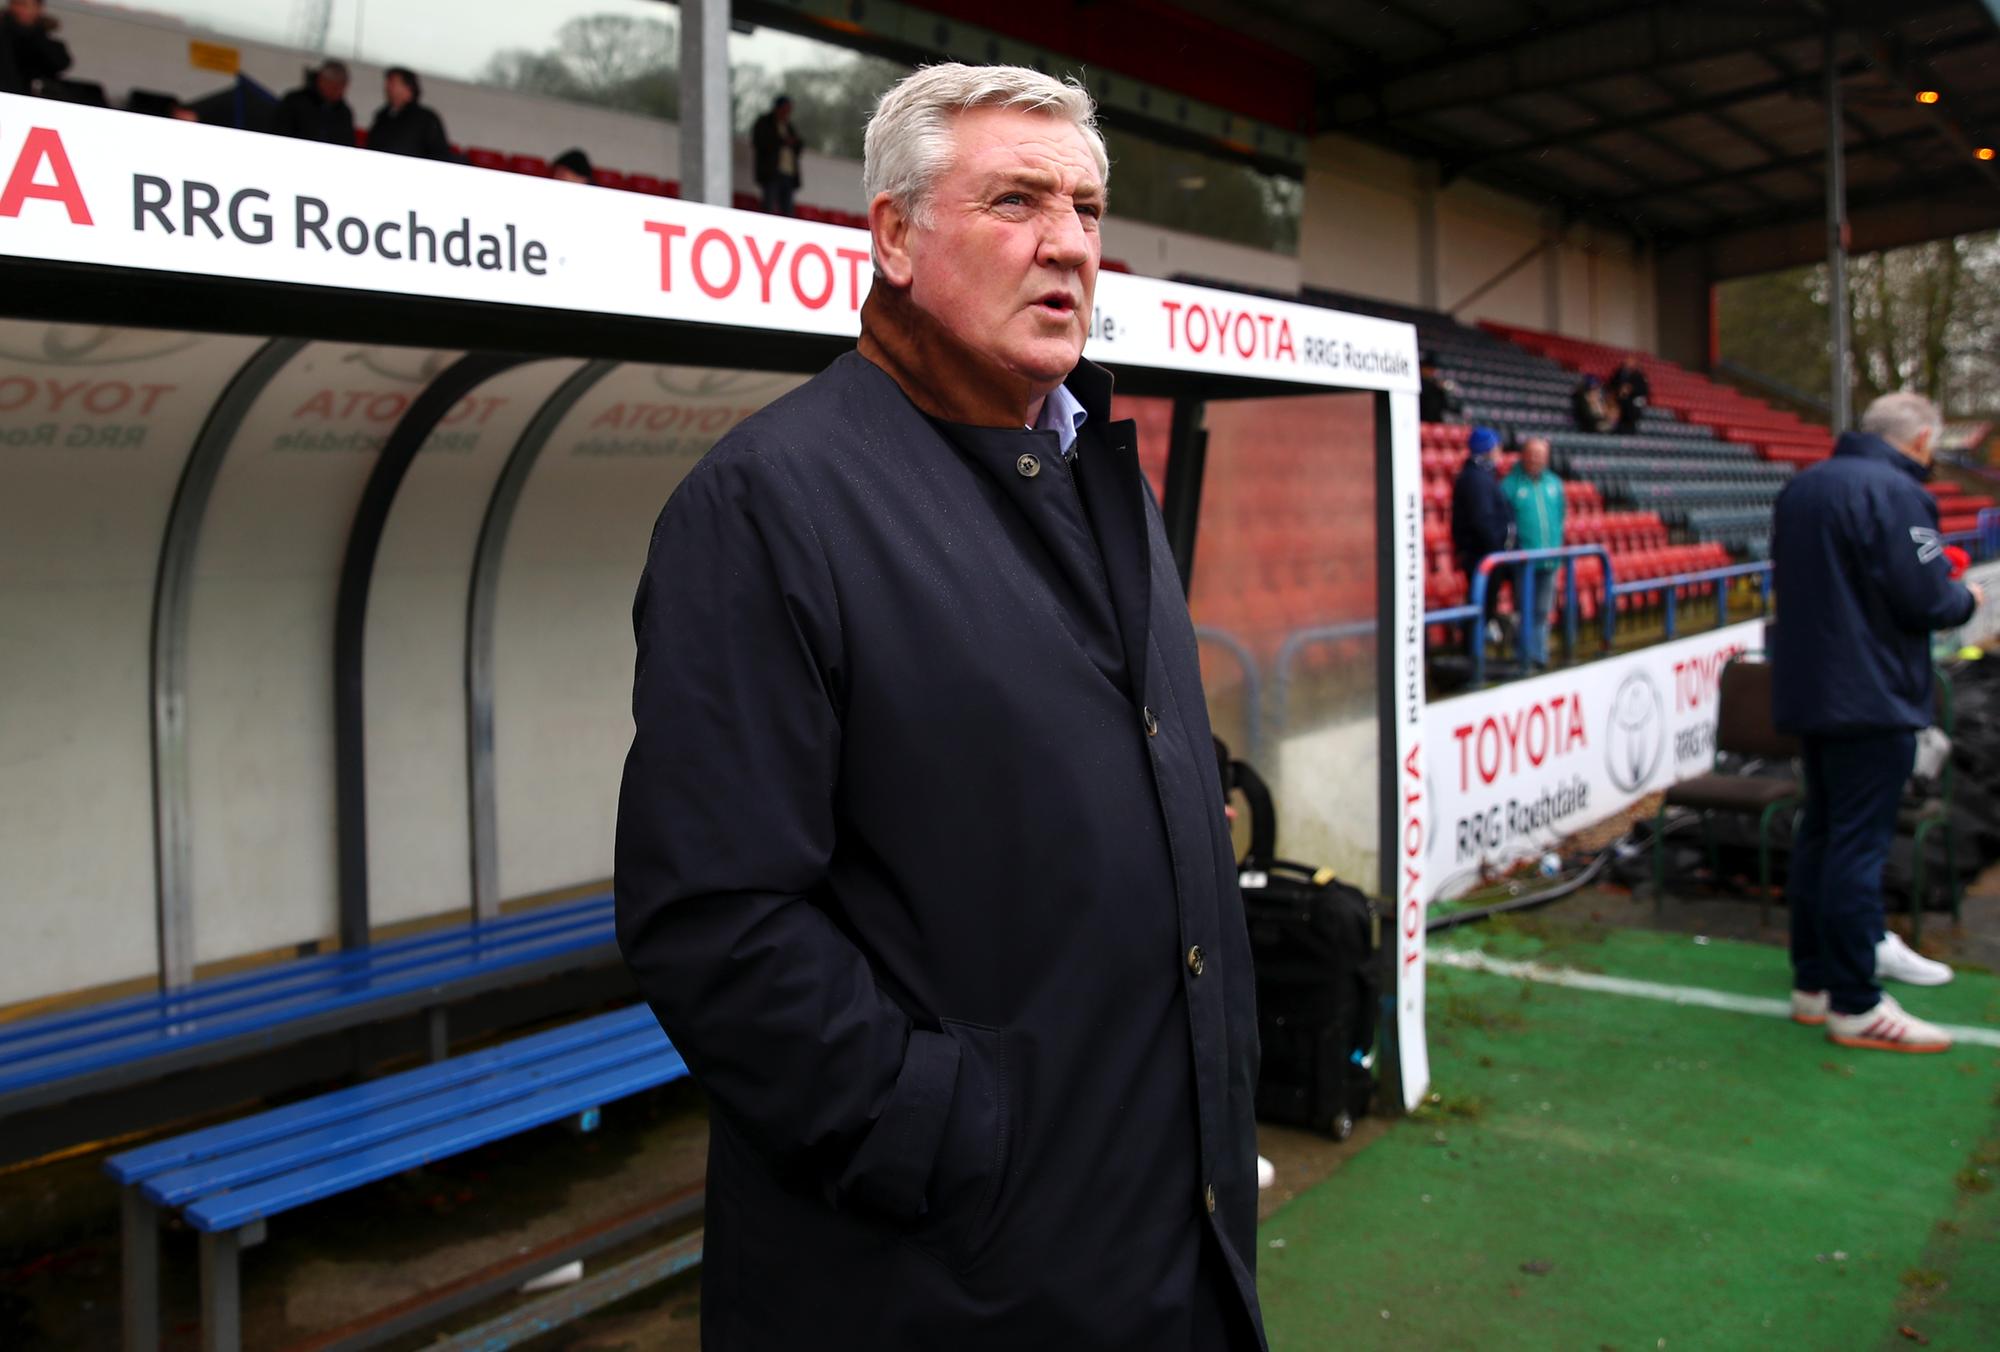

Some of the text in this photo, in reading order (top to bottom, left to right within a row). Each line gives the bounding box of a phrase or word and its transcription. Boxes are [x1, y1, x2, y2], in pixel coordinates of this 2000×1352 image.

[133, 173, 273, 245] RRG
[295, 195, 547, 275] Rochdale
[644, 220, 870, 311] TOYOT
[1162, 301, 1409, 377] TOYOTA RRG Rochdale
[1454, 694, 1587, 791] TOYOTA
[1404, 743, 1421, 977] TOYOTA
[1456, 774, 1588, 863] RRG Rochdale
